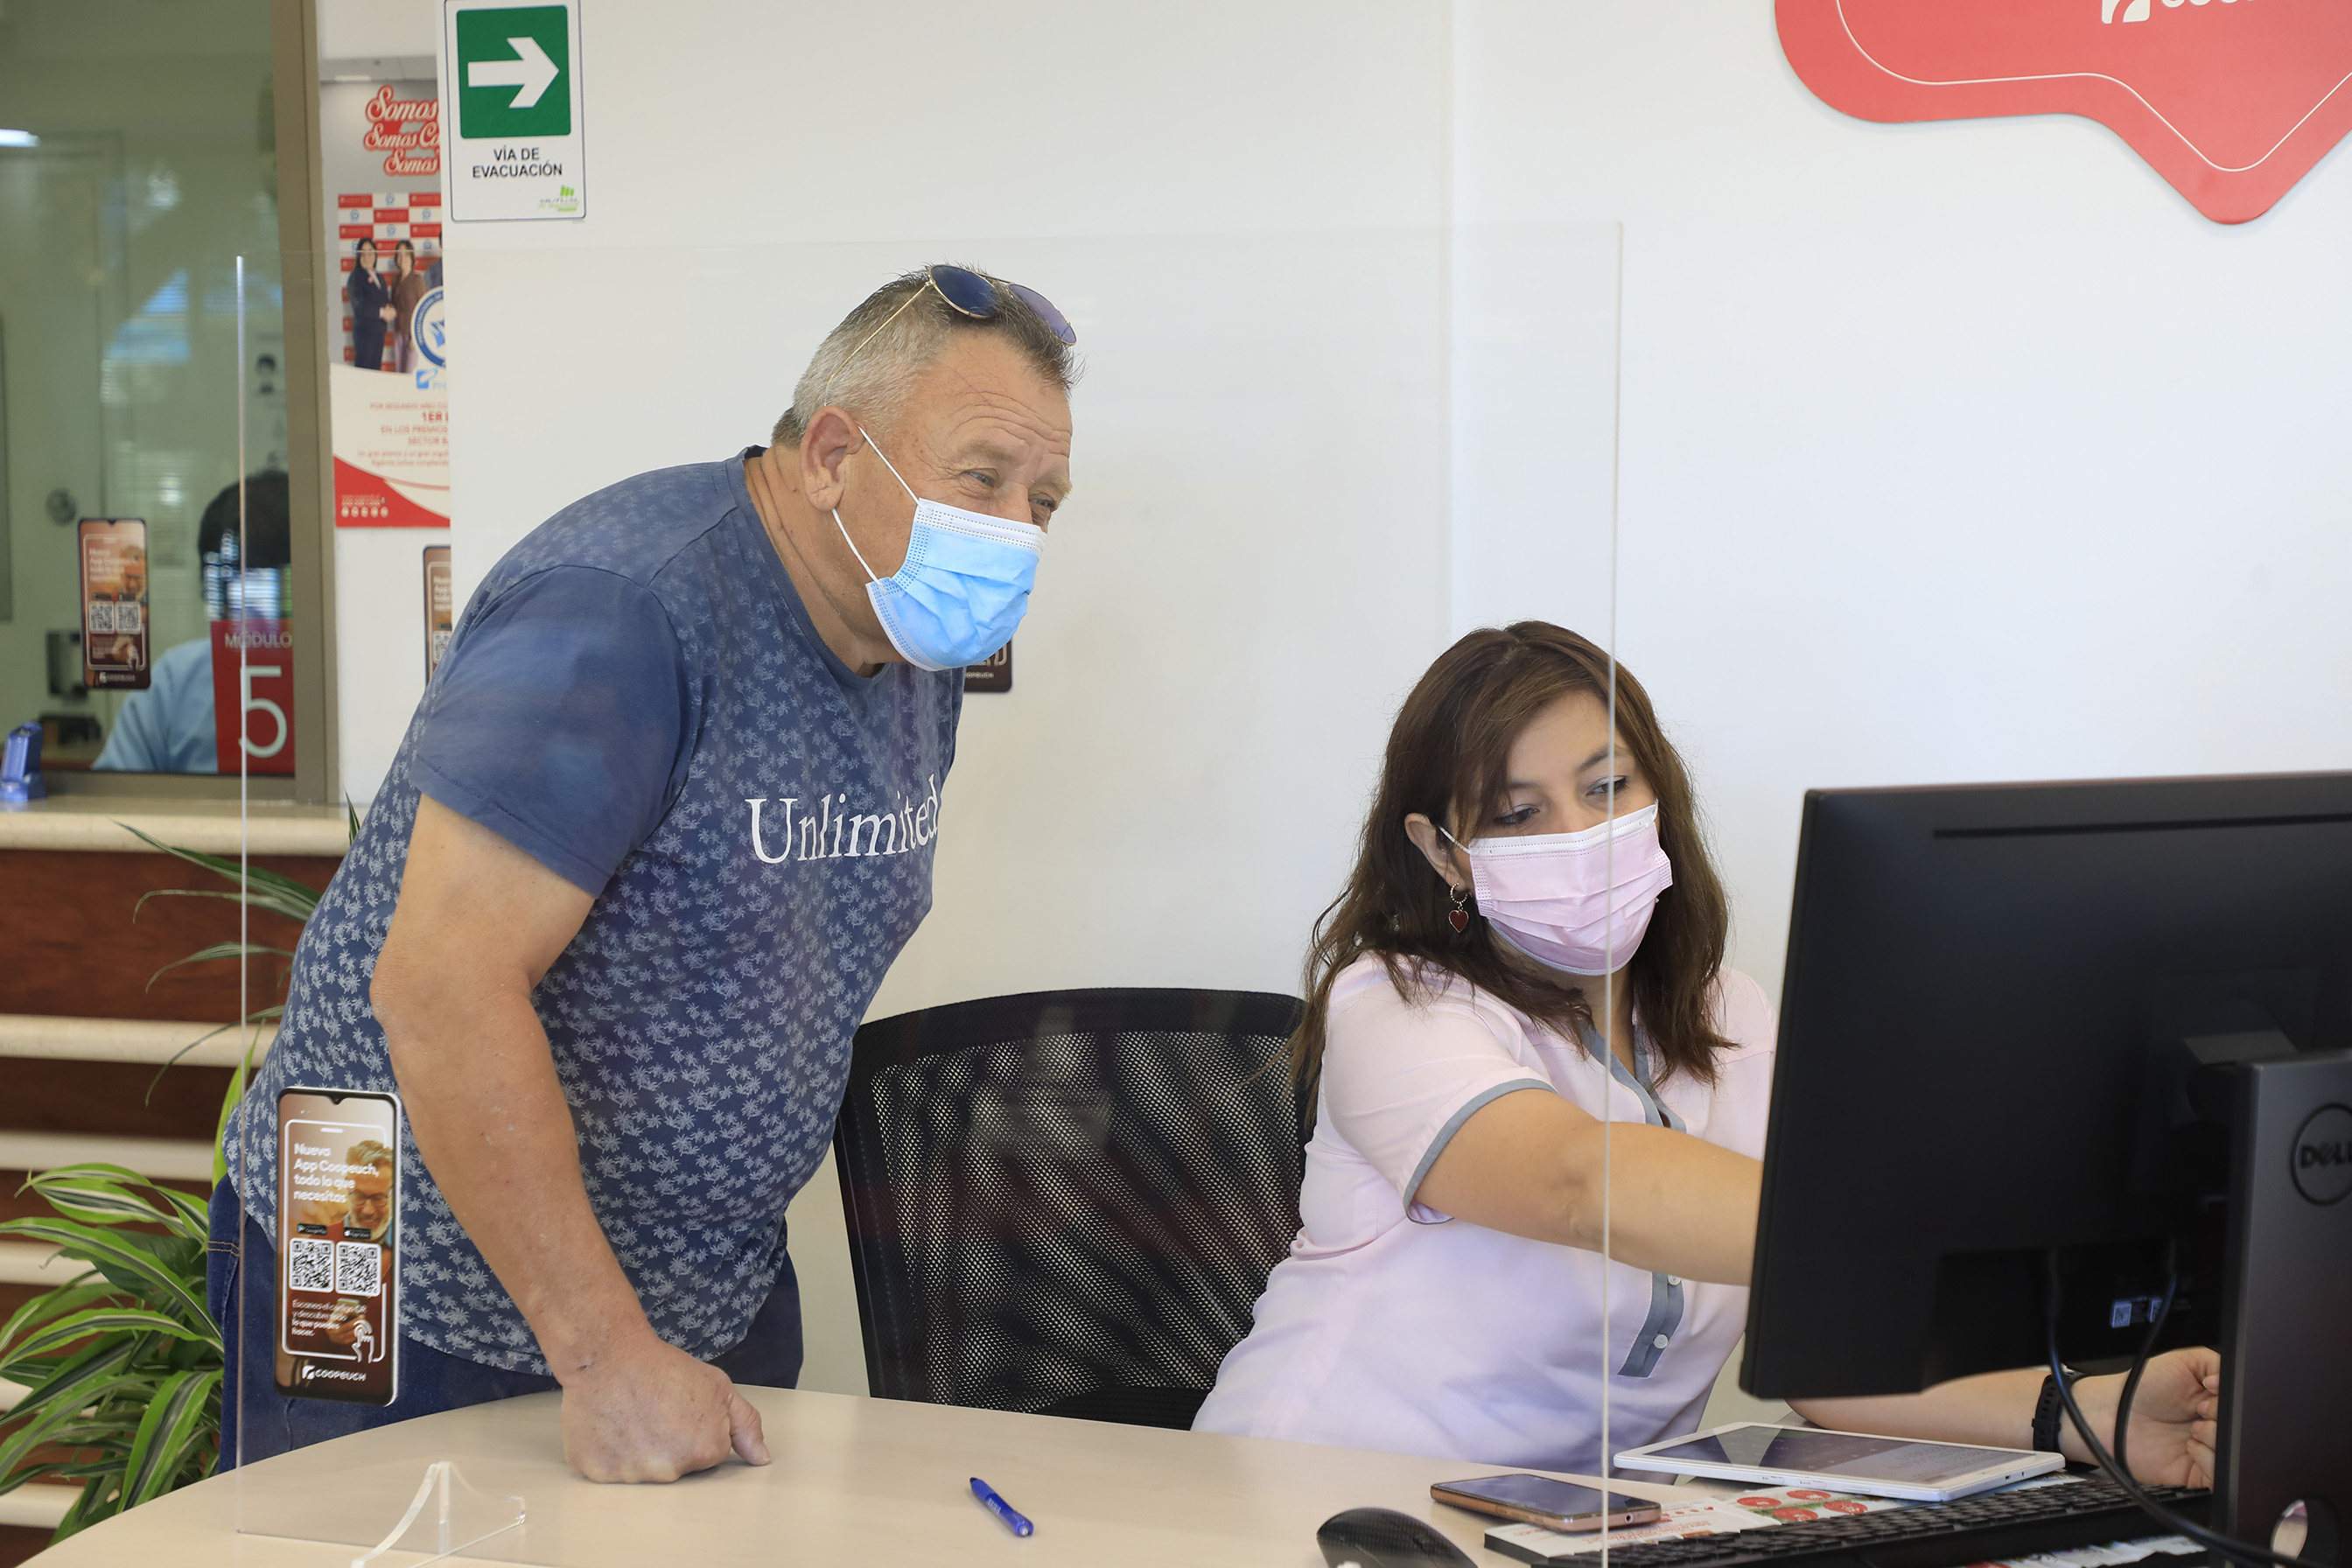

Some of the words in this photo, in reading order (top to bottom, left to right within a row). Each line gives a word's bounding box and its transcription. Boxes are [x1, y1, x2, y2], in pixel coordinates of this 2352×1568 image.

[367, 86, 438, 122] Somos
[364, 122, 417, 148] Somos
[385, 148, 438, 173] Somos
[494, 144, 517, 161] VÍA
[521, 147, 540, 160] DE
[472, 159, 563, 178] EVACUACIÓN
[422, 412, 443, 421] 1ER
[239, 665, 287, 759] 5
[745, 774, 938, 864] Unlimited
[294, 1143, 332, 1157] Nueva
[293, 1158, 318, 1173] App
[318, 1159, 380, 1178] Coopeuch,
[293, 1173, 321, 1186] todo
[321, 1175, 332, 1187] lo
[333, 1179, 356, 1190] que
[293, 1190, 347, 1203] necesitas
[292, 1299, 322, 1309] Escanea
[313, 1320, 341, 1329] puedes
[315, 1368, 367, 1382] COOPEUCH
